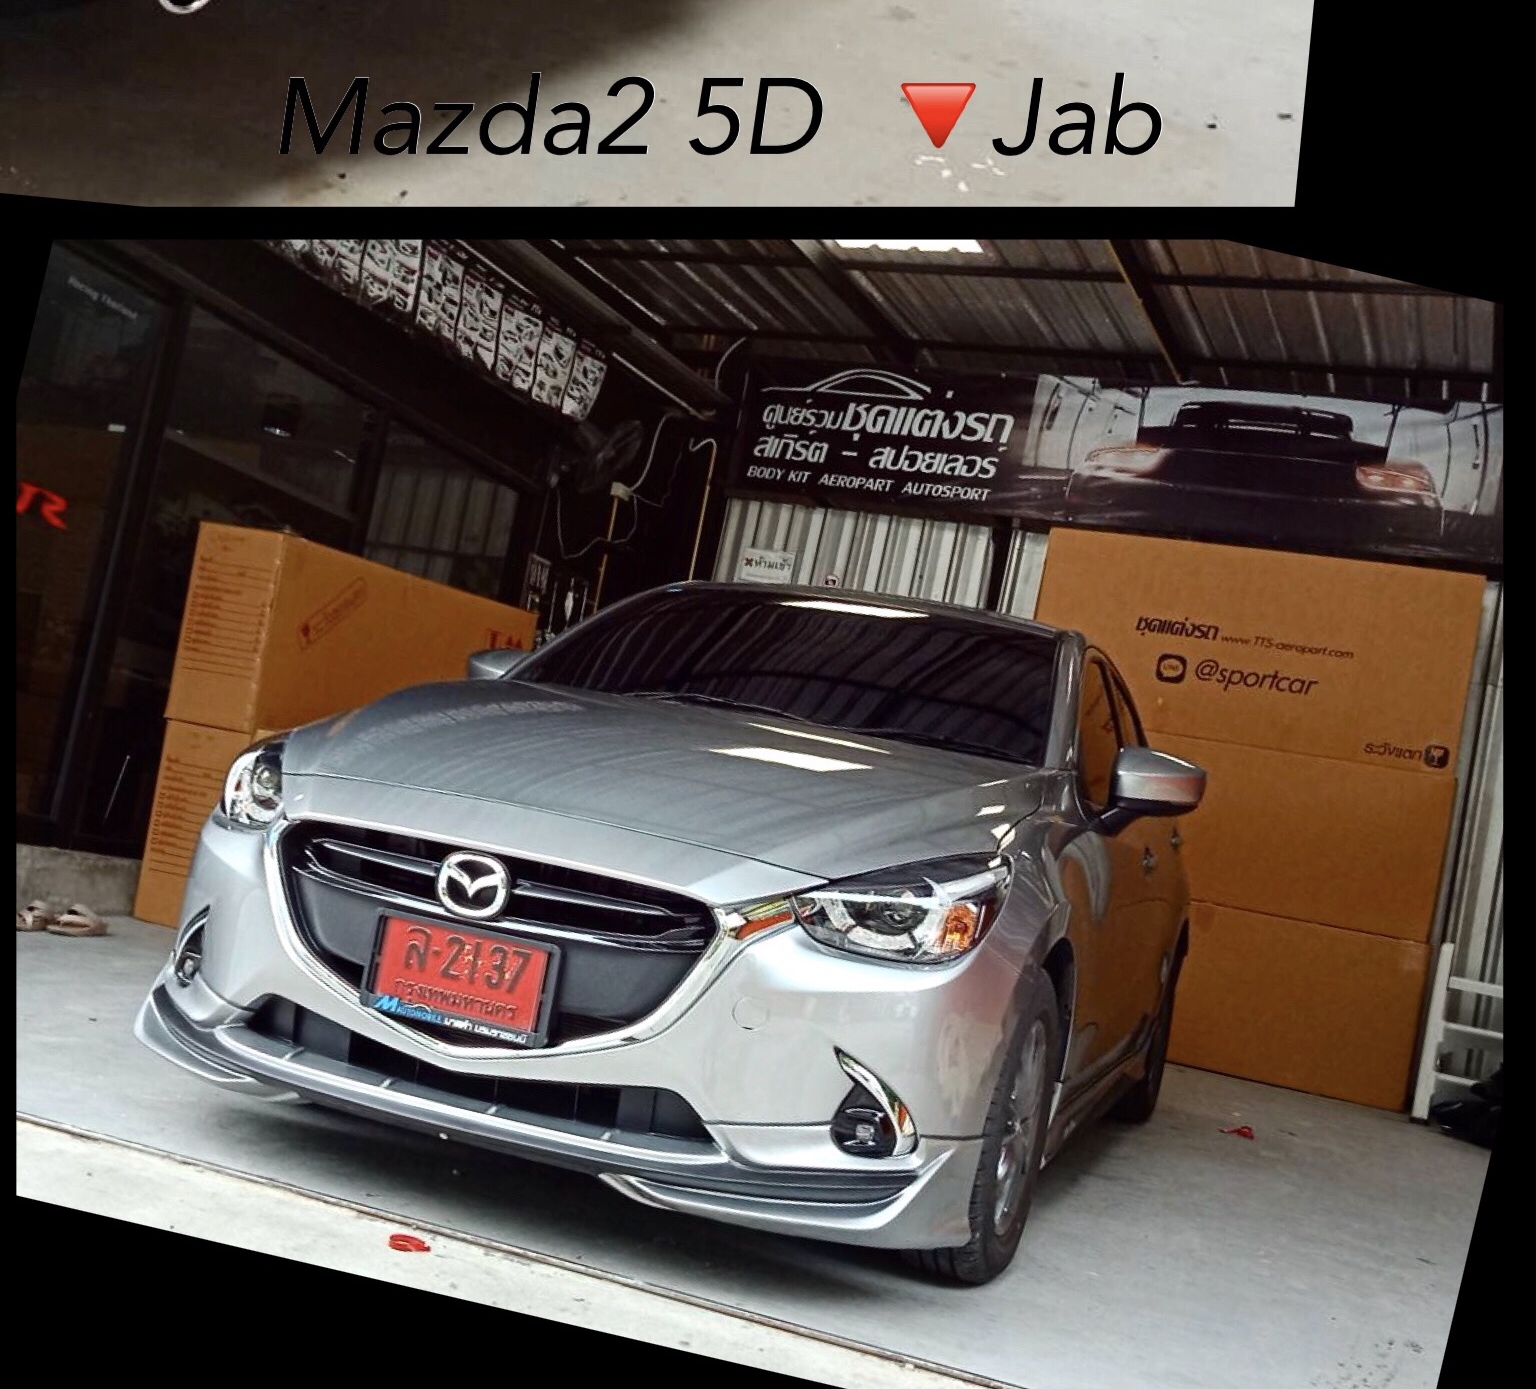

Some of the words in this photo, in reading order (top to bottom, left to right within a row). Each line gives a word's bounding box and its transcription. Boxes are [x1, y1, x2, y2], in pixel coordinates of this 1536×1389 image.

[746, 465, 785, 482] BODY
[787, 468, 812, 485] KIT
[817, 472, 895, 493] AEROPART
[901, 481, 992, 502] AUTOSPORT
[1194, 659, 1320, 697] @sportcar
